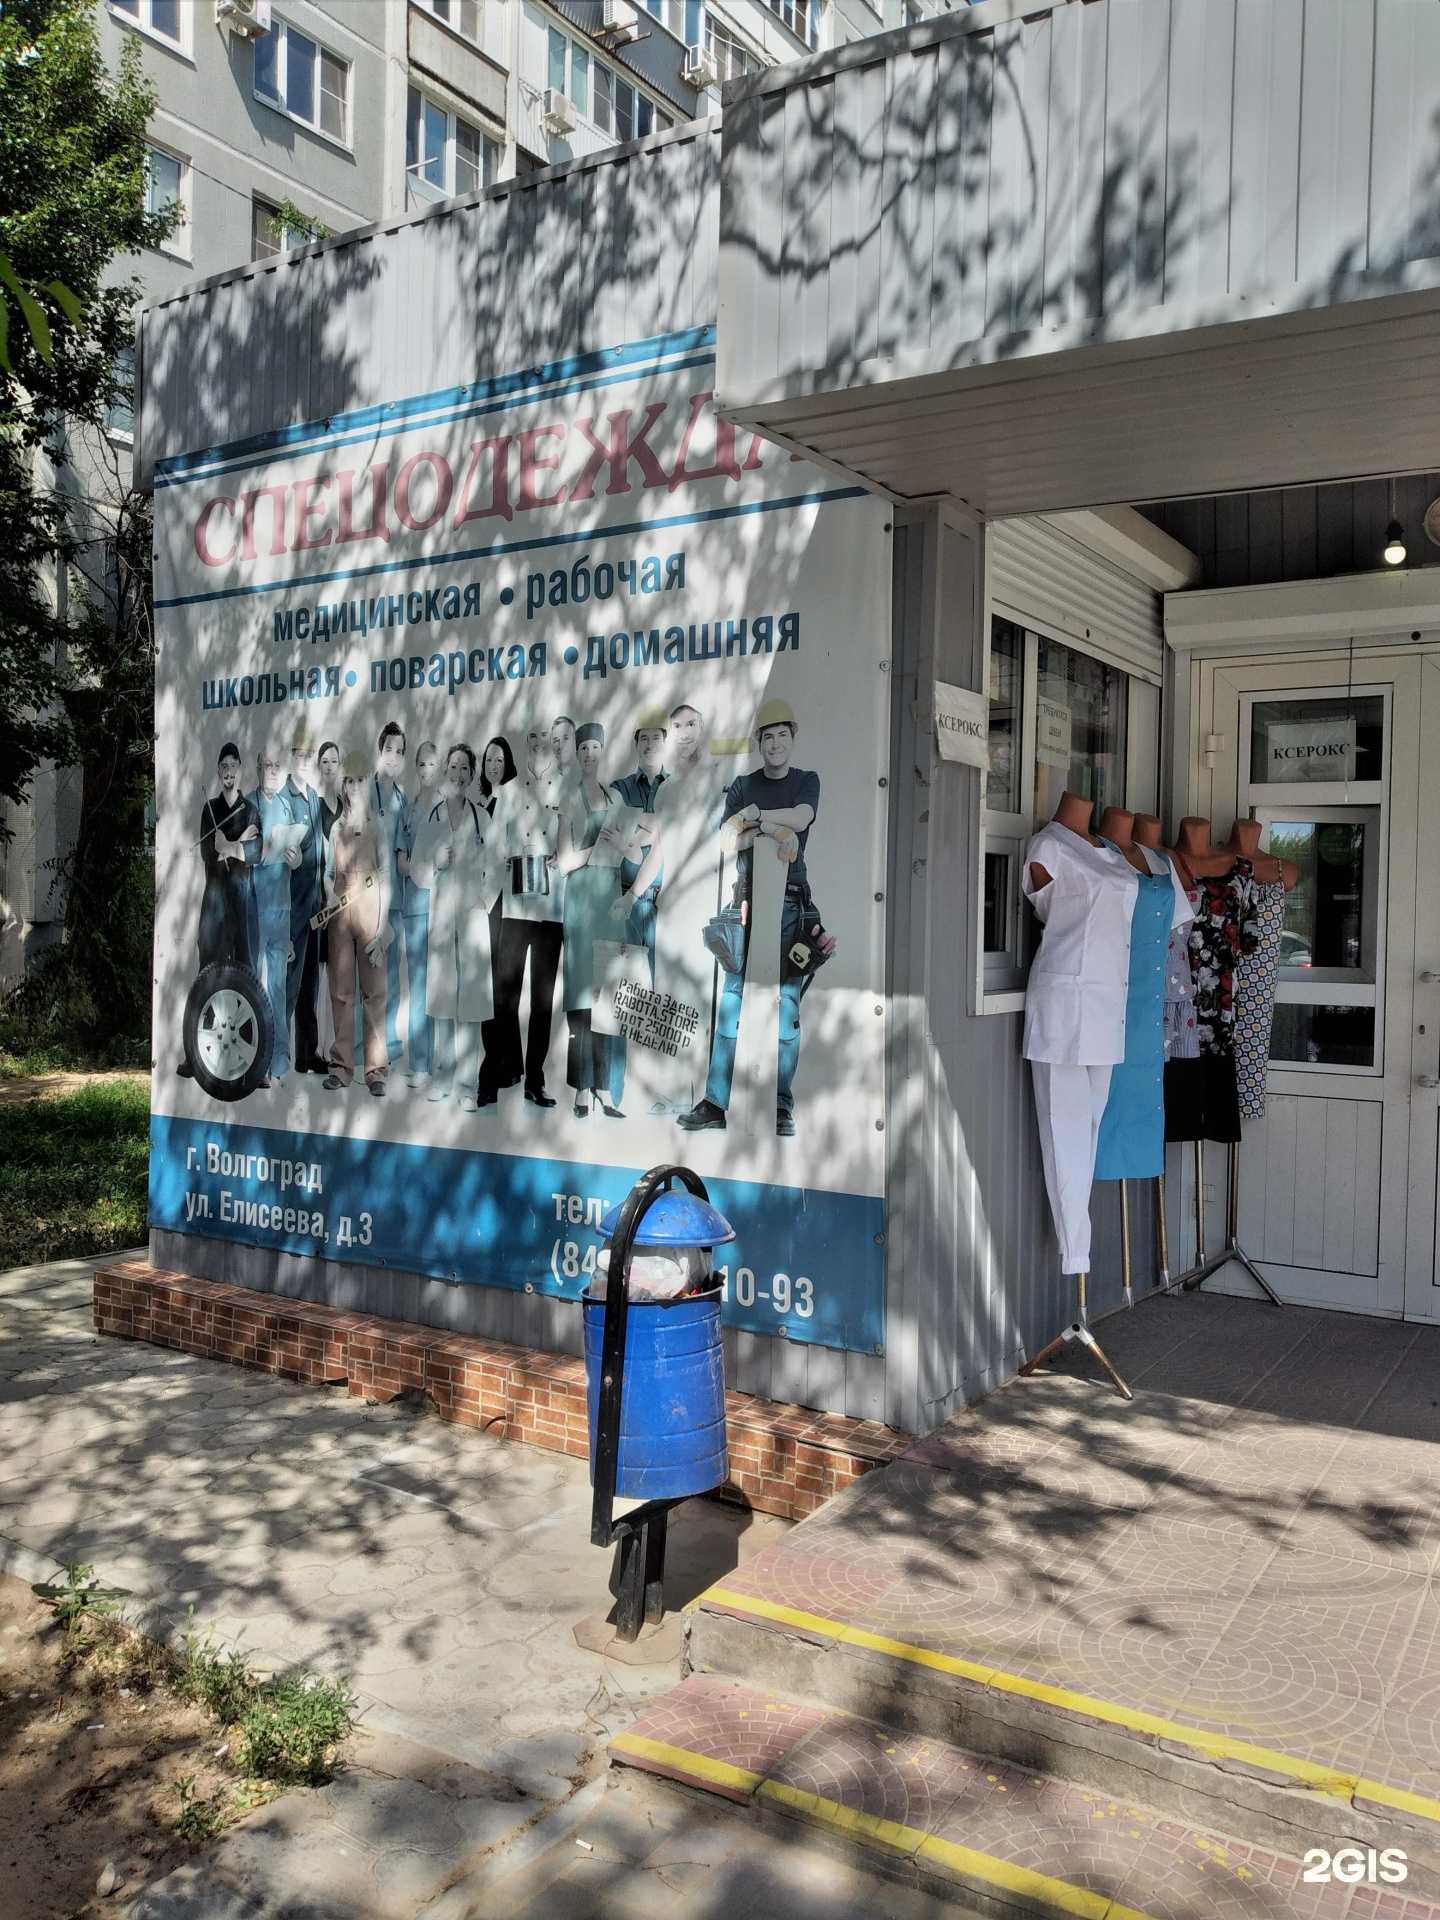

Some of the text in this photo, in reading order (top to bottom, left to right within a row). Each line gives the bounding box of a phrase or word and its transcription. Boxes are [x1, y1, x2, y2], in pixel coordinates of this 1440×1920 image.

[273, 552, 685, 644] медицинская рабочая
[202, 612, 800, 710] школьная поварская домашняя
[938, 713, 983, 738] КСЕРОКС
[1273, 743, 1350, 759] КСЕРОКС
[619, 977, 661, 1005] Работа
[629, 1026, 678, 1057] НЕДЕЛЮ
[645, 1017, 682, 1044] 25000
[187, 1143, 323, 1194] г. Волгоград
[186, 1191, 373, 1248] ул. Елисеева, д.3
